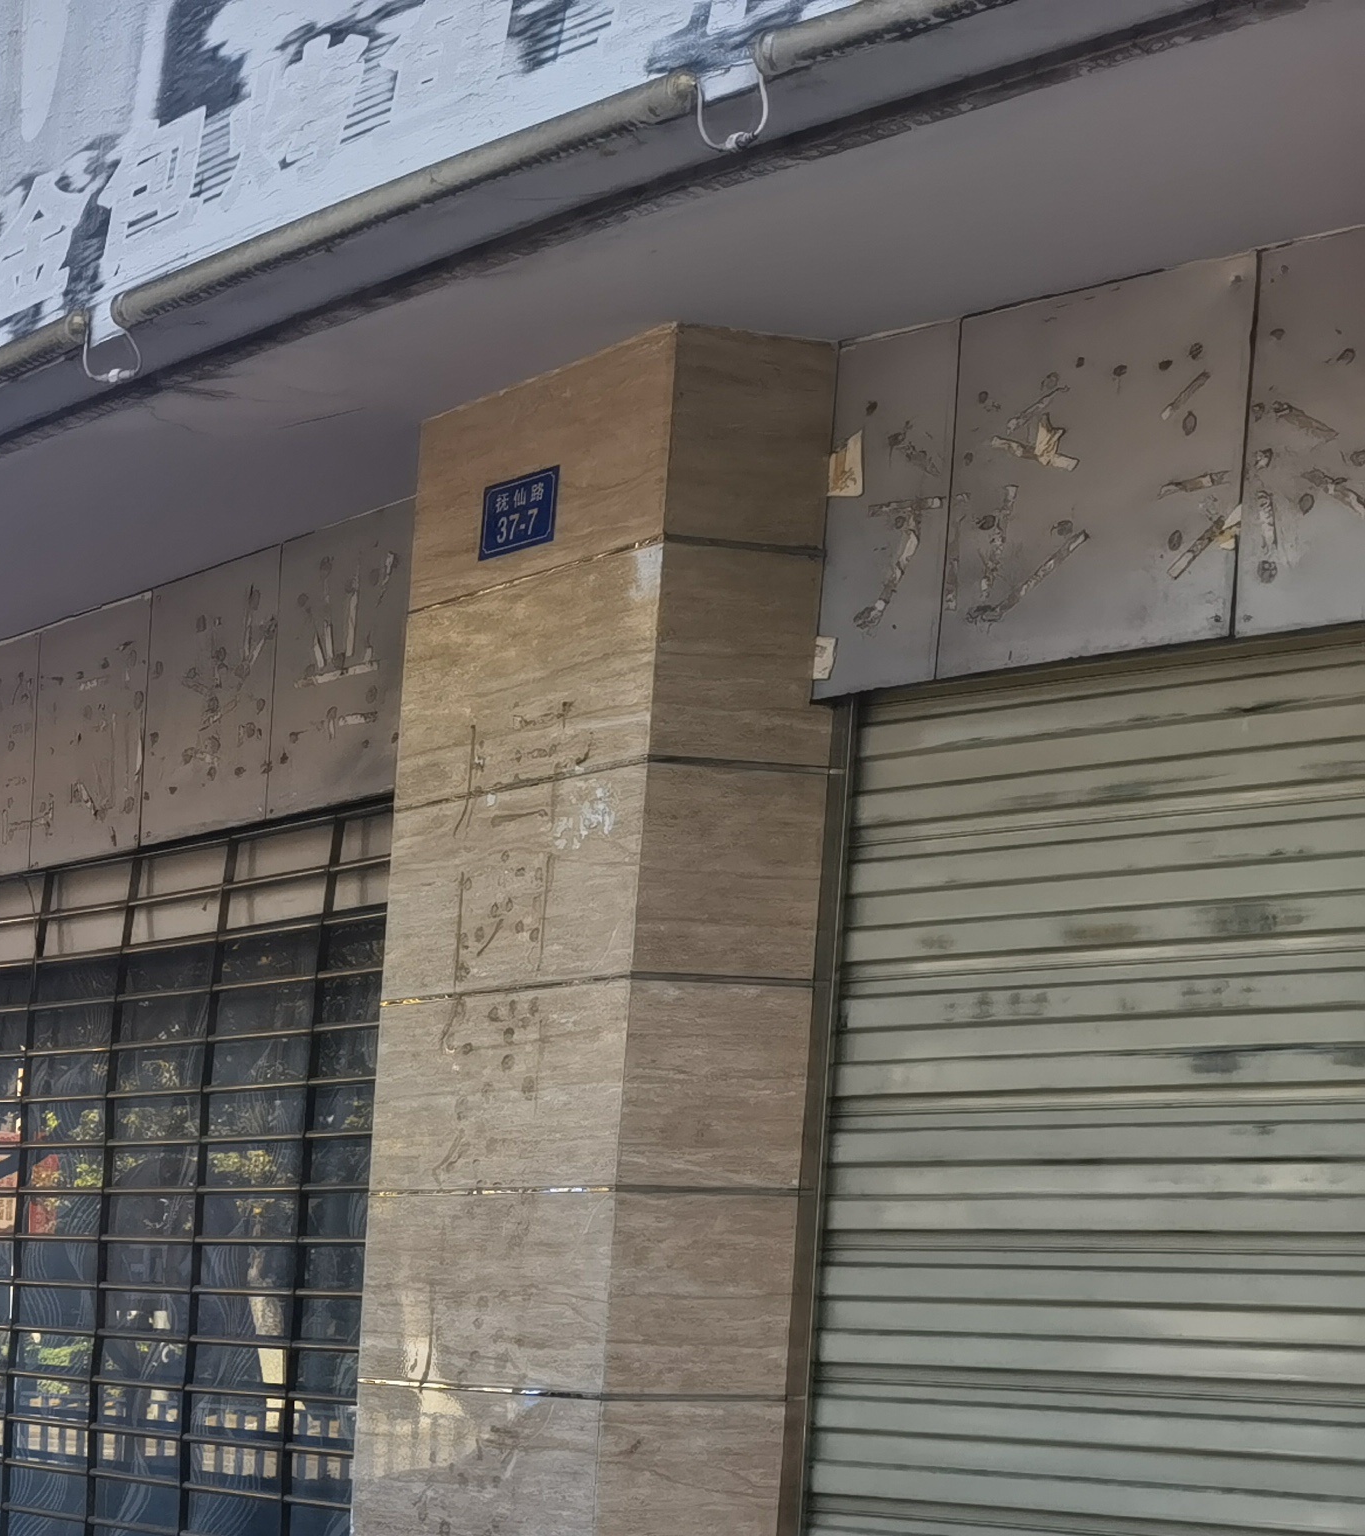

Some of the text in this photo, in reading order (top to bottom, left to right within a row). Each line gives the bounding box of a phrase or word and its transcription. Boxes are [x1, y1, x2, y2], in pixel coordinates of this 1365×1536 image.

[495, 481, 545, 514] 抚仙路
[496, 507, 539, 544] 37-7
